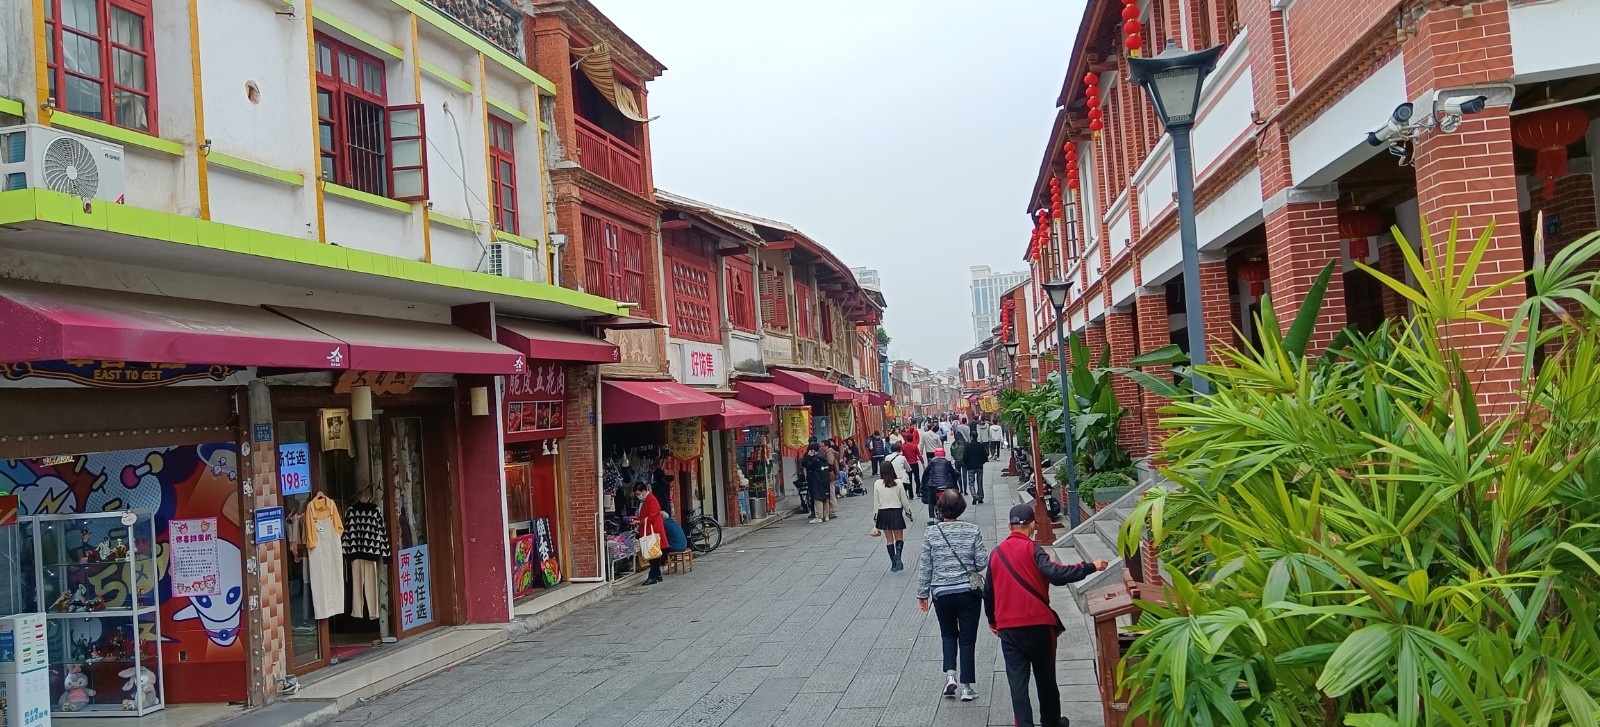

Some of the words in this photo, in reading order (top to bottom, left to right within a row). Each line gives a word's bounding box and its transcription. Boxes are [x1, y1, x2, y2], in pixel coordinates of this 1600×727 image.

[93, 369, 122, 380] EAST
[124, 369, 139, 380] TO
[141, 370, 162, 380] GET
[690, 350, 715, 377] 好饰集
[509, 362, 565, 396] 脆皮五花肉
[282, 472, 308, 491] 198元
[413, 549, 427, 620] 全场任选
